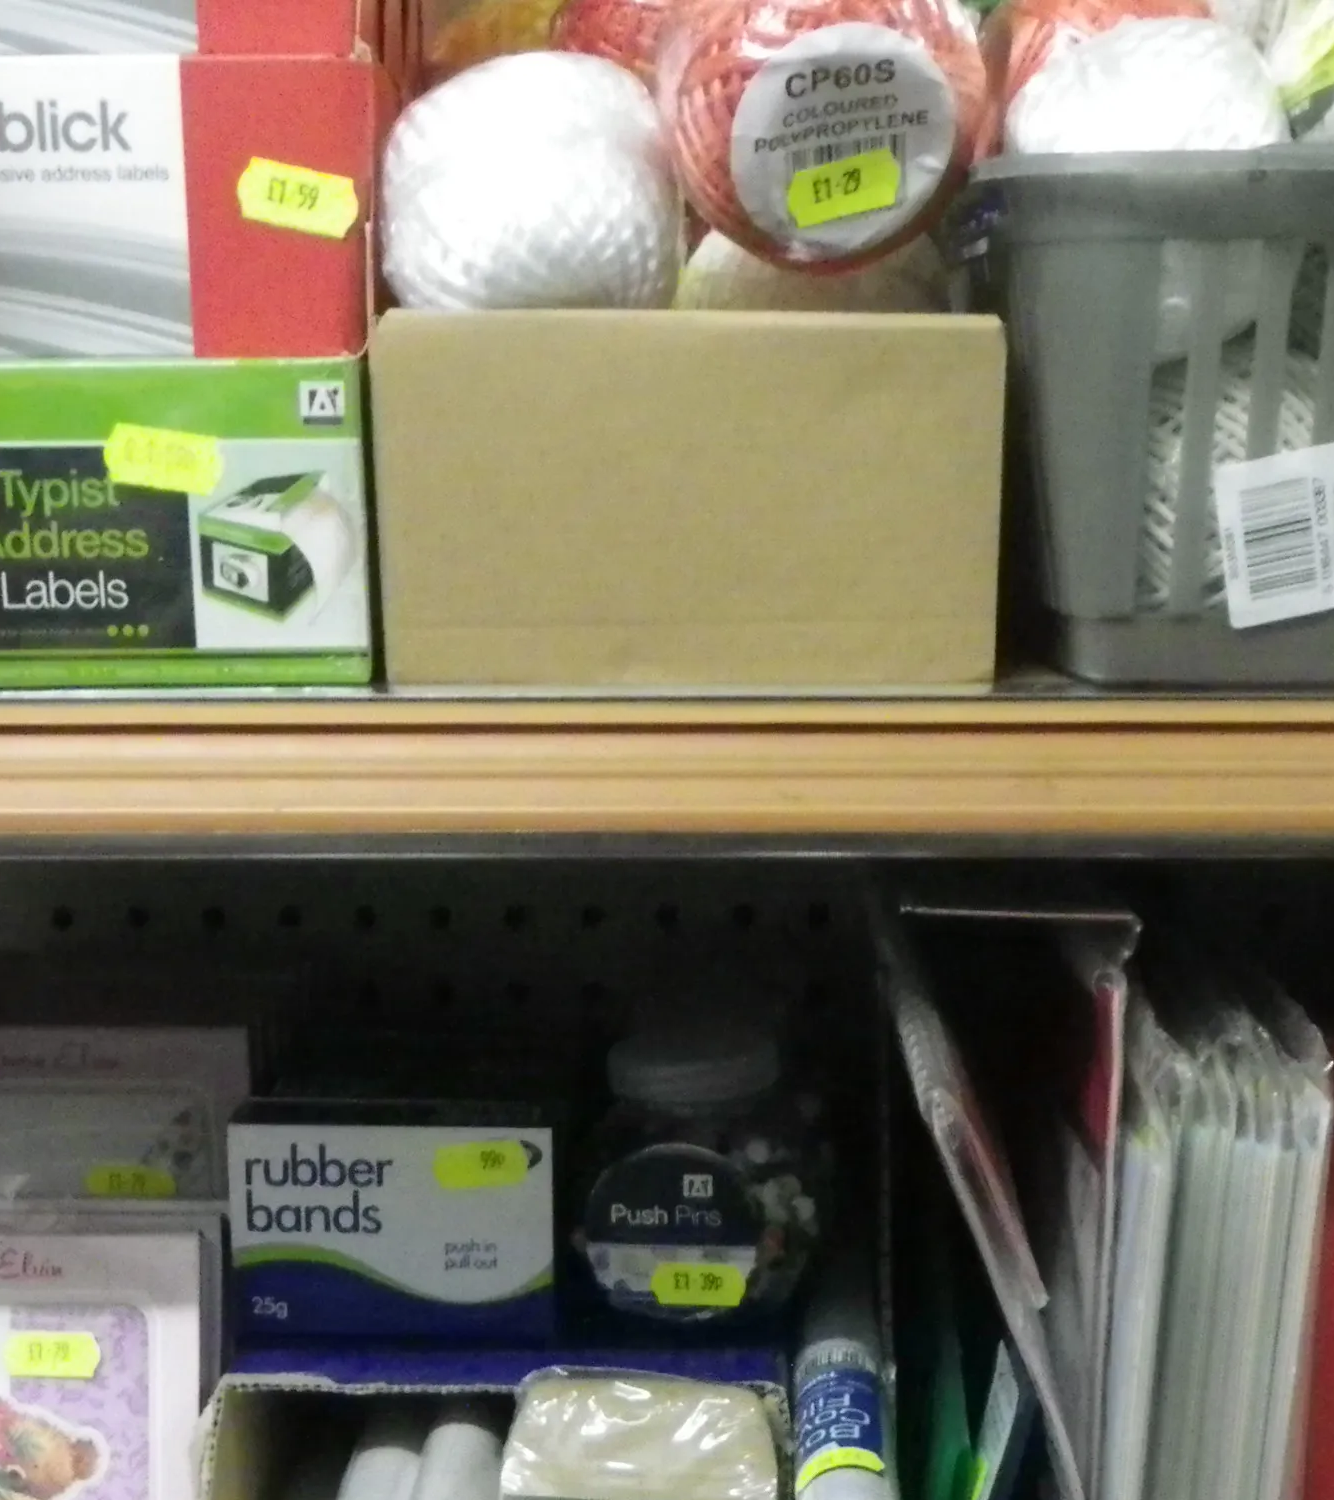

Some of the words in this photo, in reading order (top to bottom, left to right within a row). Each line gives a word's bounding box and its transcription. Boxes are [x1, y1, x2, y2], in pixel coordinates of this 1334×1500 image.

[784, 58, 896, 99] CP60S
[782, 93, 899, 128] COLOURED
[754, 109, 929, 153] POLYPROPYLENE
[0, 571, 130, 610] Labels
[244, 1144, 393, 1190] rubber
[244, 1191, 384, 1236] bands
[610, 1202, 669, 1228] Push
[674, 1204, 722, 1228] Pins
[252, 1295, 290, 1320] 25g
